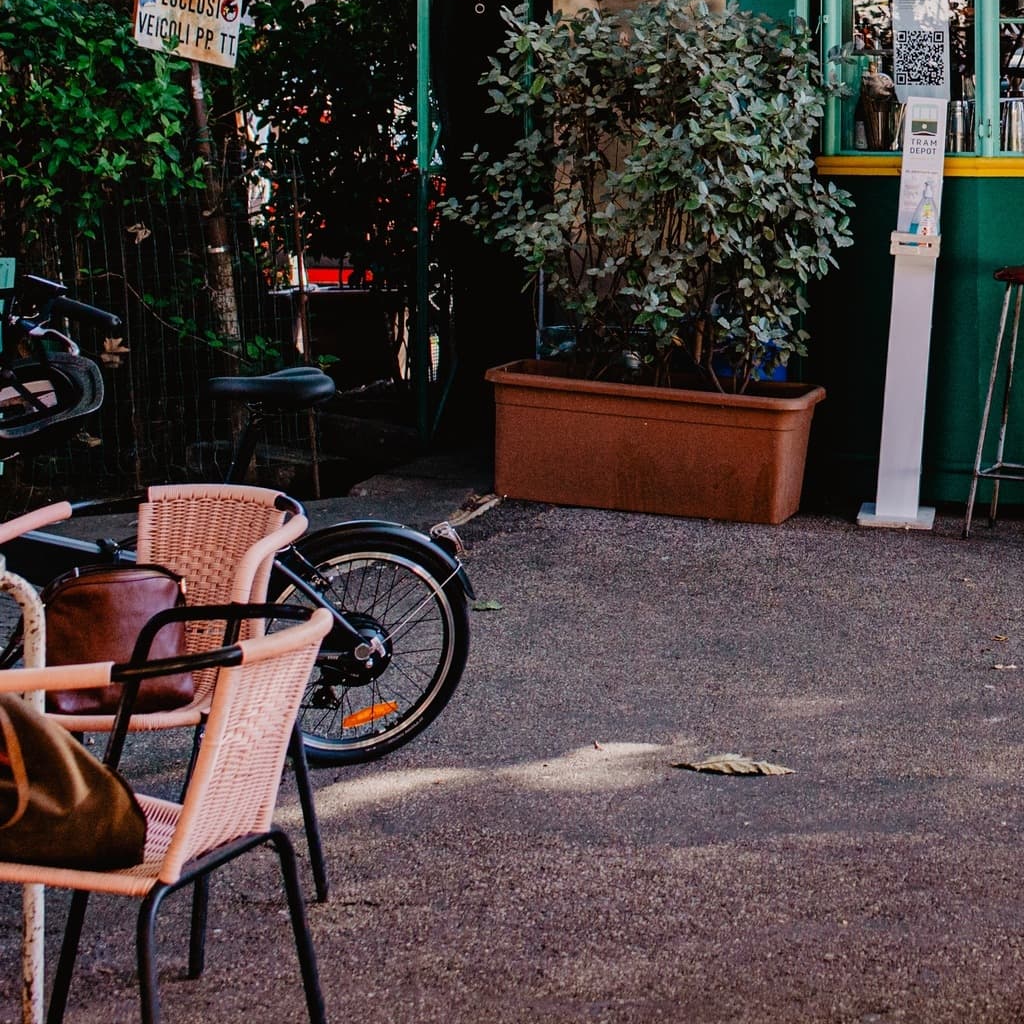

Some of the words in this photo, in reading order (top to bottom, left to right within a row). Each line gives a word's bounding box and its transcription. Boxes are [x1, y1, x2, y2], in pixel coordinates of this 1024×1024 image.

[139, 11, 190, 45] VEICOLI
[911, 138, 937, 146] TRAM
[910, 147, 937, 155] DEPOT
